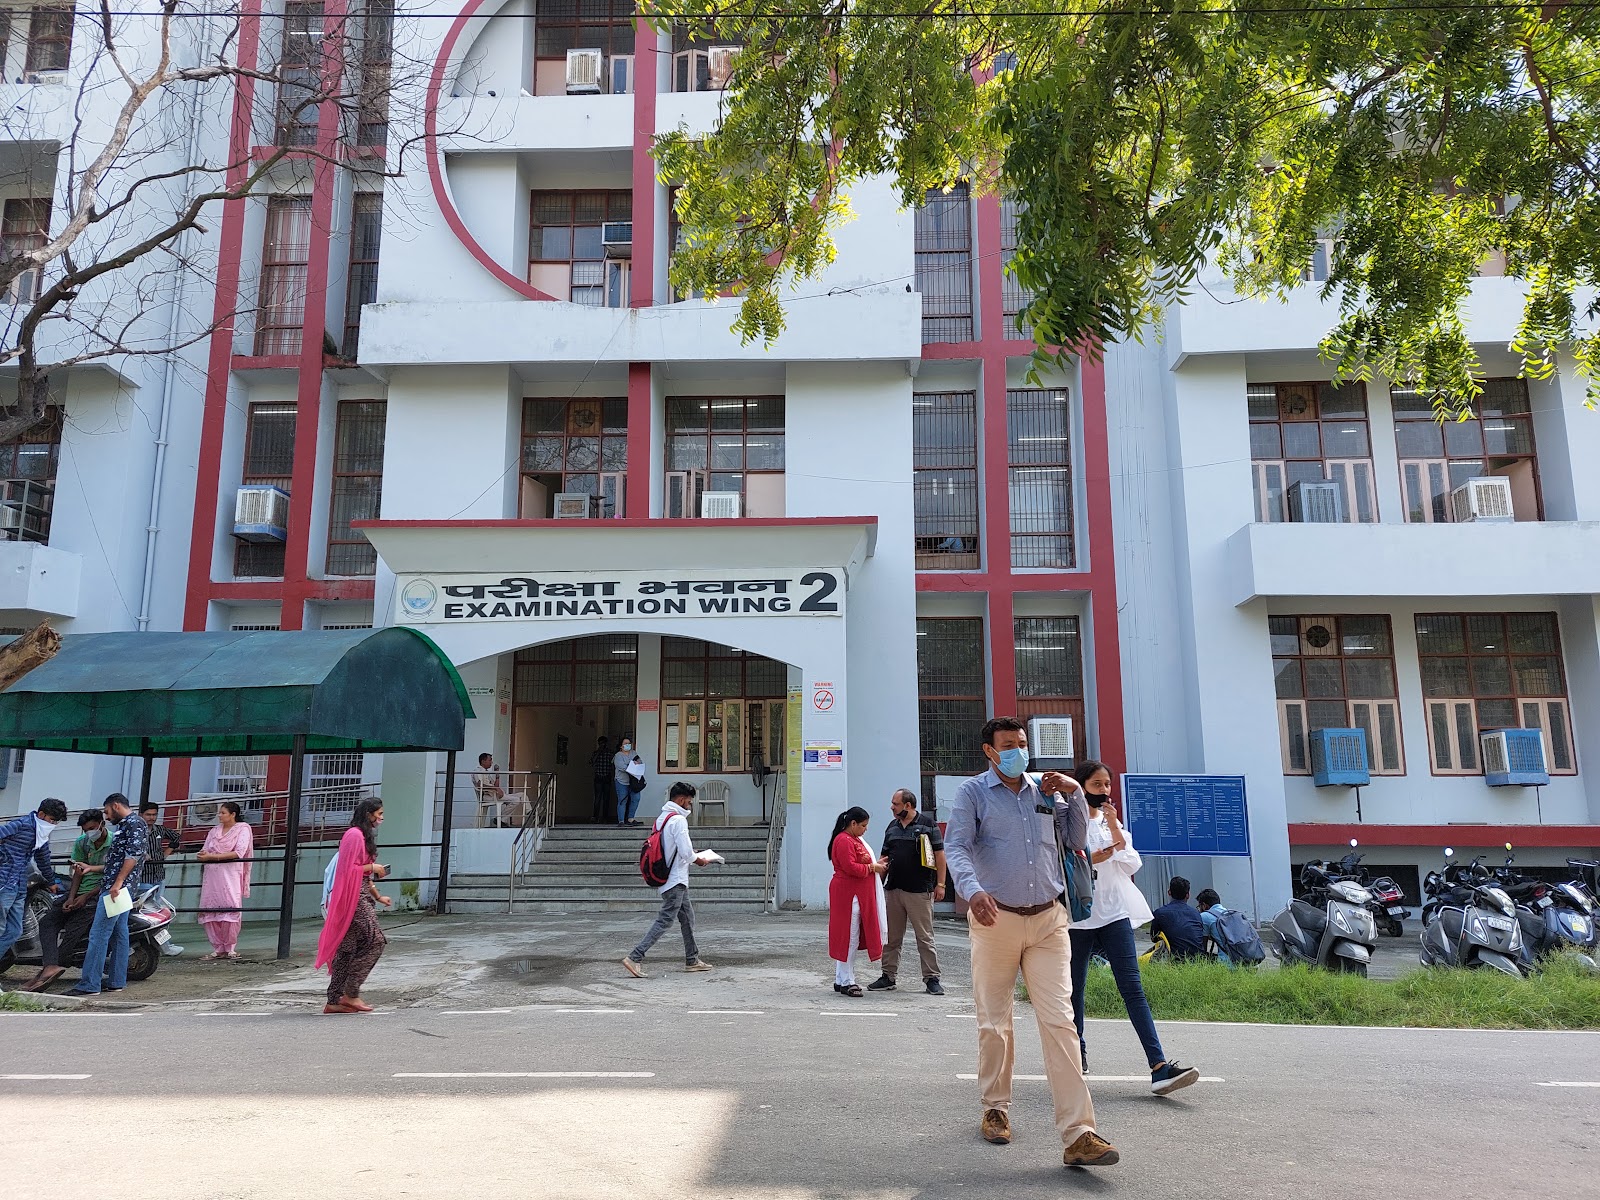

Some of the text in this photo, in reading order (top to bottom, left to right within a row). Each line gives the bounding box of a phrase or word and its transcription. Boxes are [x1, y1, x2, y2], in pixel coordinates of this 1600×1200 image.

[441, 577, 792, 599] परीक्षा भवन
[799, 572, 838, 612] 2
[444, 597, 791, 618] EXAMINATION WING
